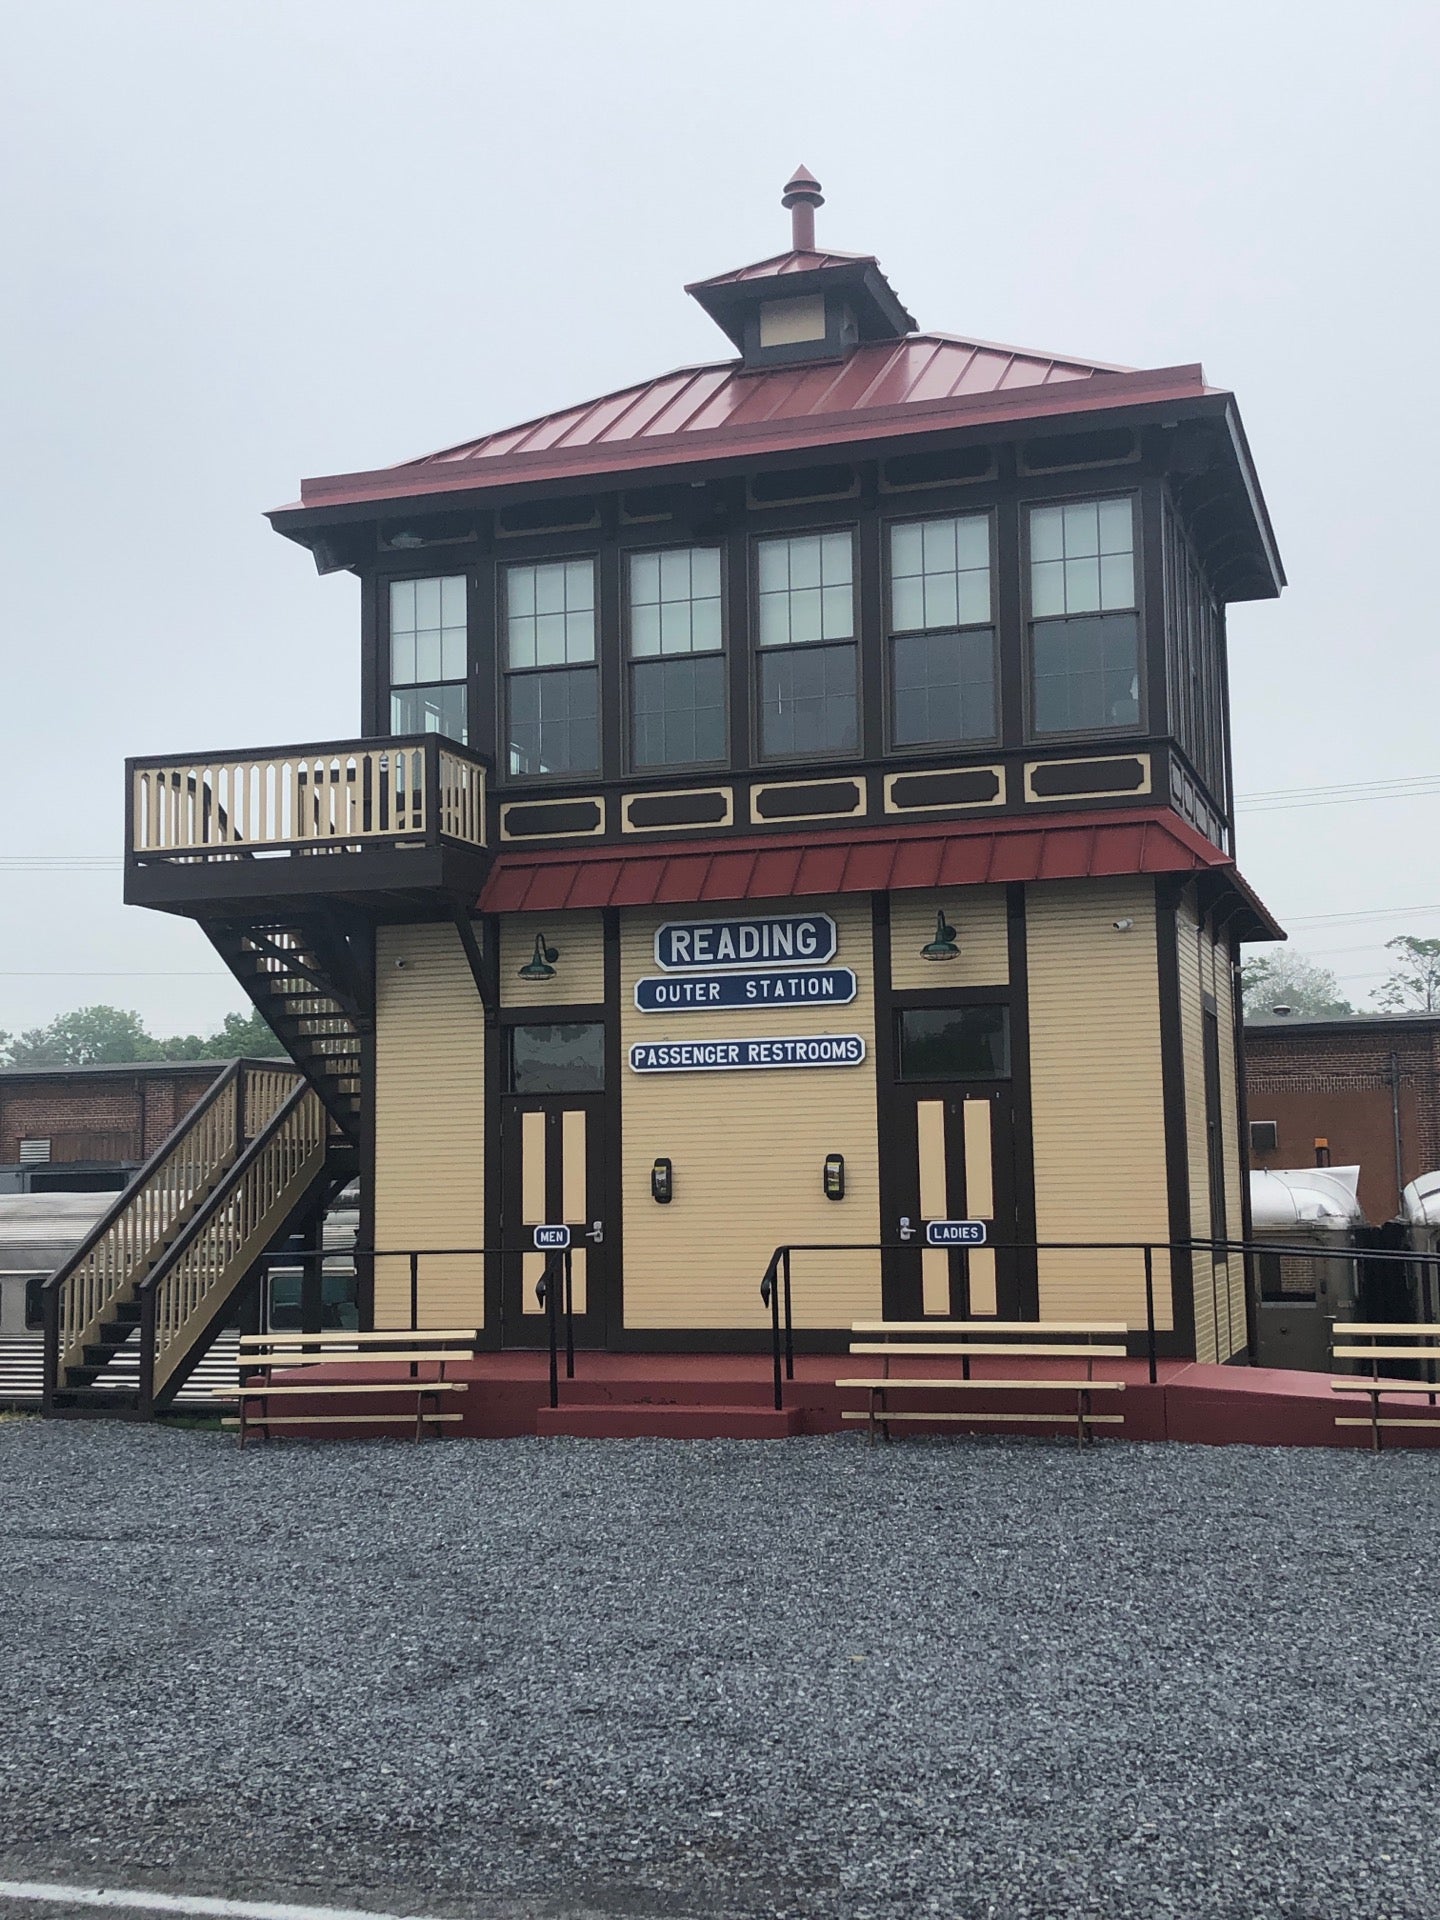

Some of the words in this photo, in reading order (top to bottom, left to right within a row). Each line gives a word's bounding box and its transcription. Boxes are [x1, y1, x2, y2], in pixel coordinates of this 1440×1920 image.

[671, 922, 818, 962] READING
[655, 983, 720, 1002] OUTER
[746, 978, 834, 998] STATION
[635, 1045, 739, 1066] PASSENGER
[748, 1041, 858, 1062] RESTROOMS
[540, 1231, 563, 1242] MEN
[934, 1227, 978, 1239] LADIES
